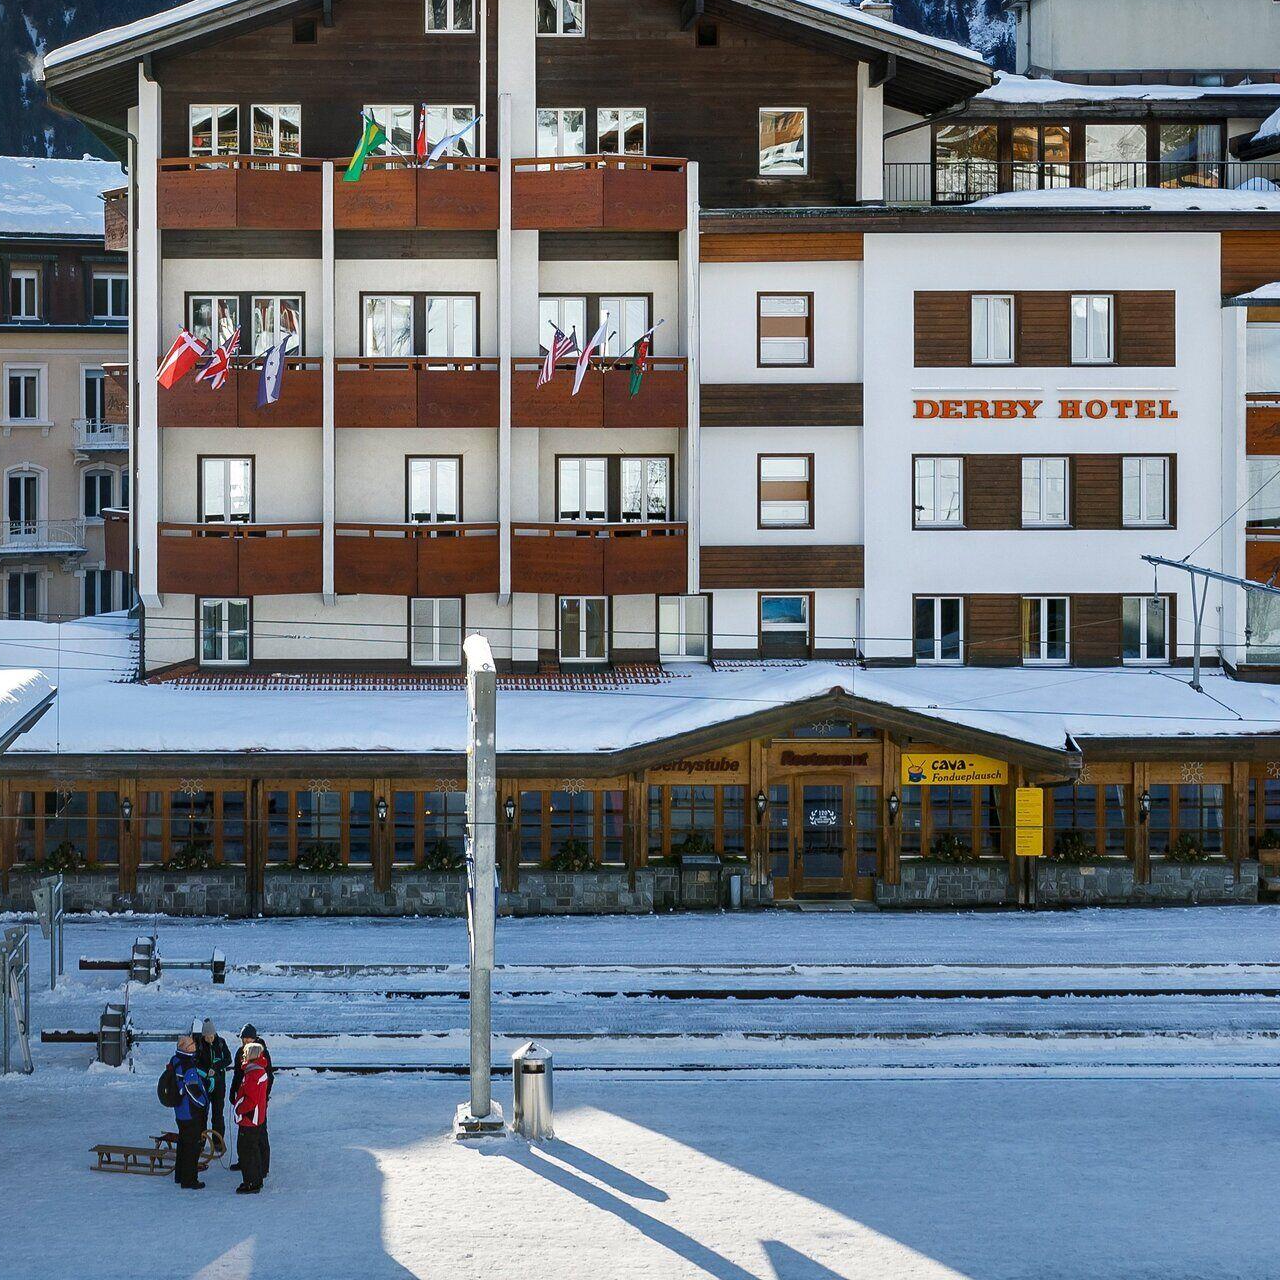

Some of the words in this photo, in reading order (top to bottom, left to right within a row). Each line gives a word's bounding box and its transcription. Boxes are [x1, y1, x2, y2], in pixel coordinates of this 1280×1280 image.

[913, 400, 1043, 419] DERBY
[1058, 400, 1178, 419] HOTEL
[931, 770, 1002, 782] Fondueplausch
